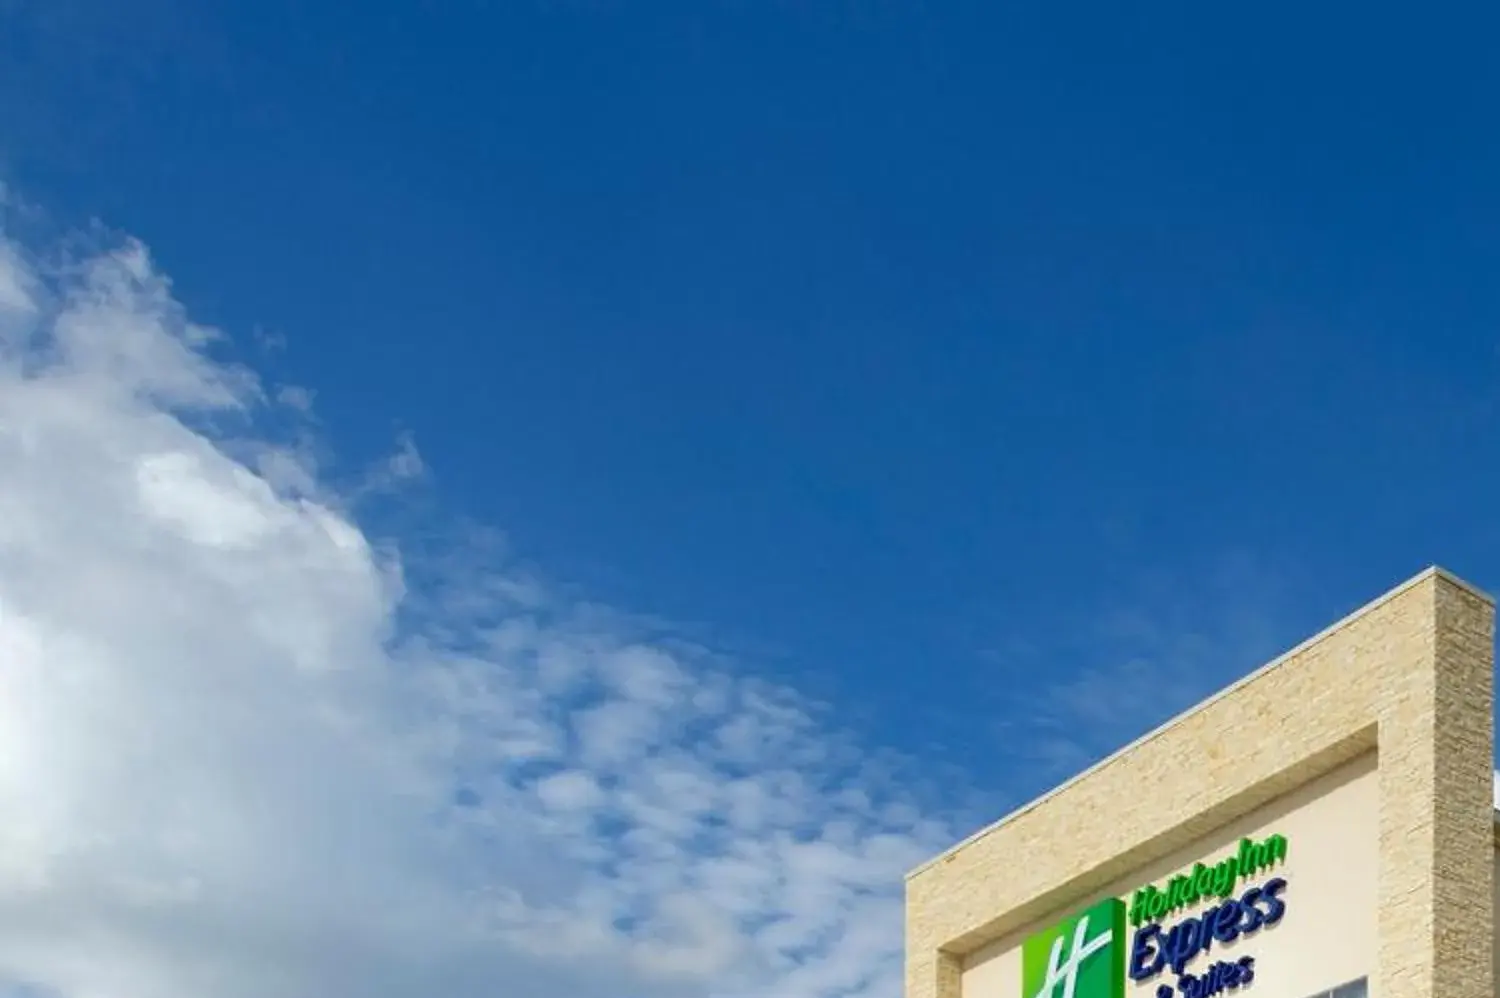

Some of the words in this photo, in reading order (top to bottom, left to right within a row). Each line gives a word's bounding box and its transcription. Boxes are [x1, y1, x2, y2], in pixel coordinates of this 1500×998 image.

[1129, 857, 1239, 926] Holiday
[1237, 834, 1287, 881] Inn
[1129, 877, 1287, 983] Express
